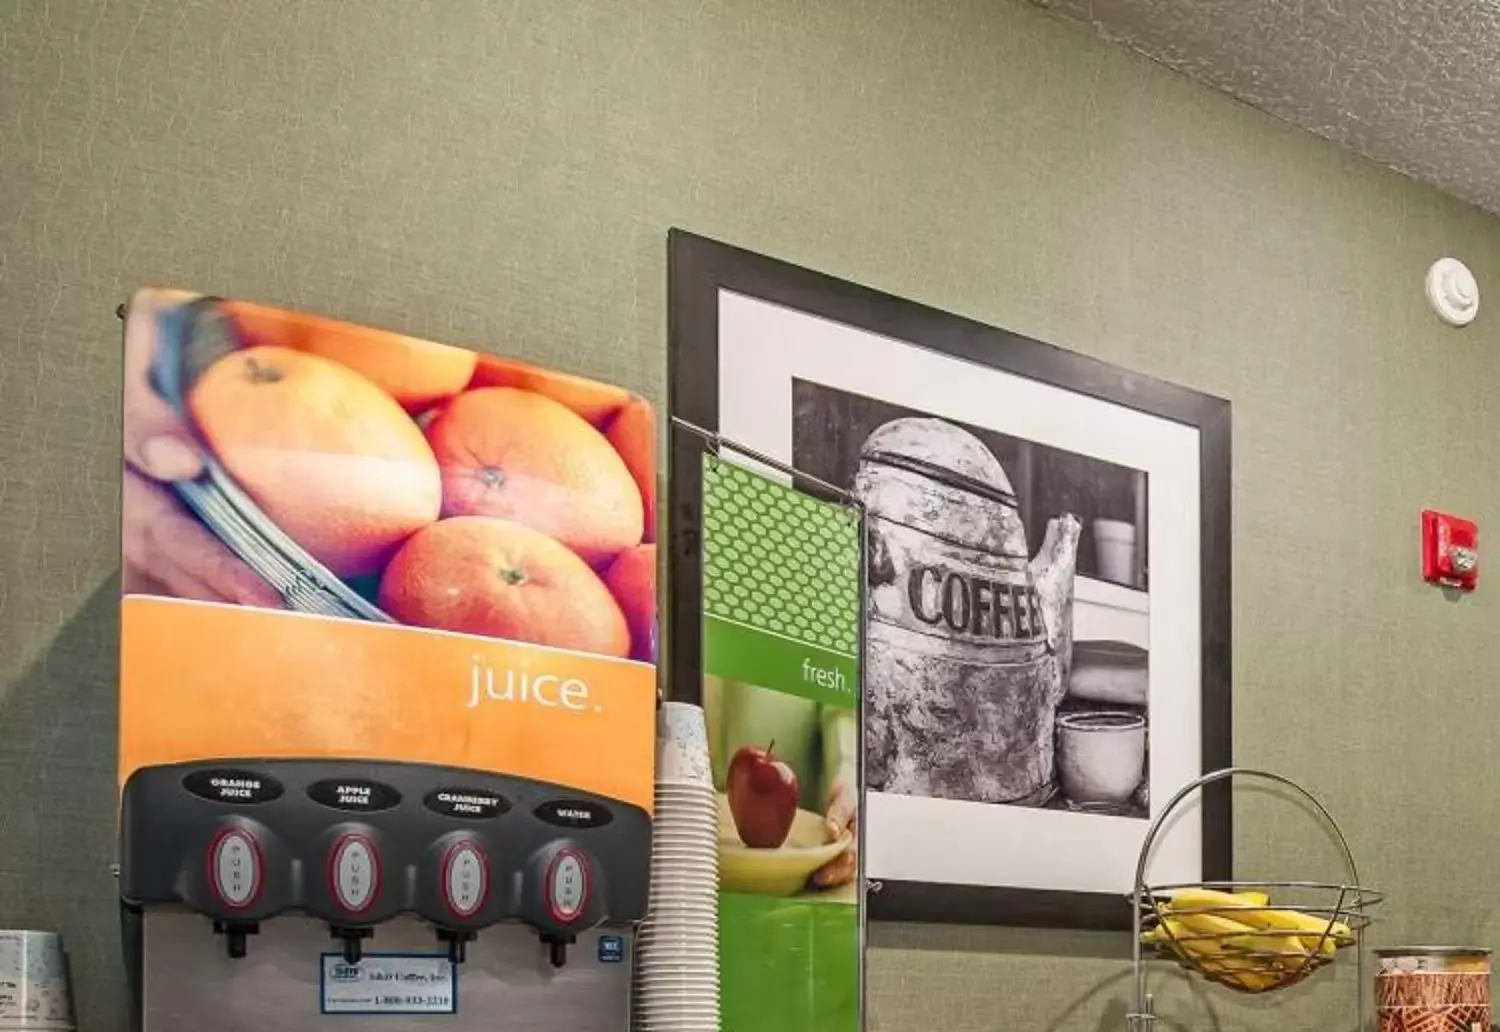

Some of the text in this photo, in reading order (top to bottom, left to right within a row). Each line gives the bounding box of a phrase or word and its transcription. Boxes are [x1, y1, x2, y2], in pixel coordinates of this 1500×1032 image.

[908, 564, 1042, 639] COFFEE
[465, 653, 602, 713] juice.
[802, 658, 851, 693] fresh.
[220, 788, 251, 798] JUICE
[336, 786, 371, 796] APPLE
[339, 795, 369, 805] JUICE
[350, 851, 361, 897] PUSH
